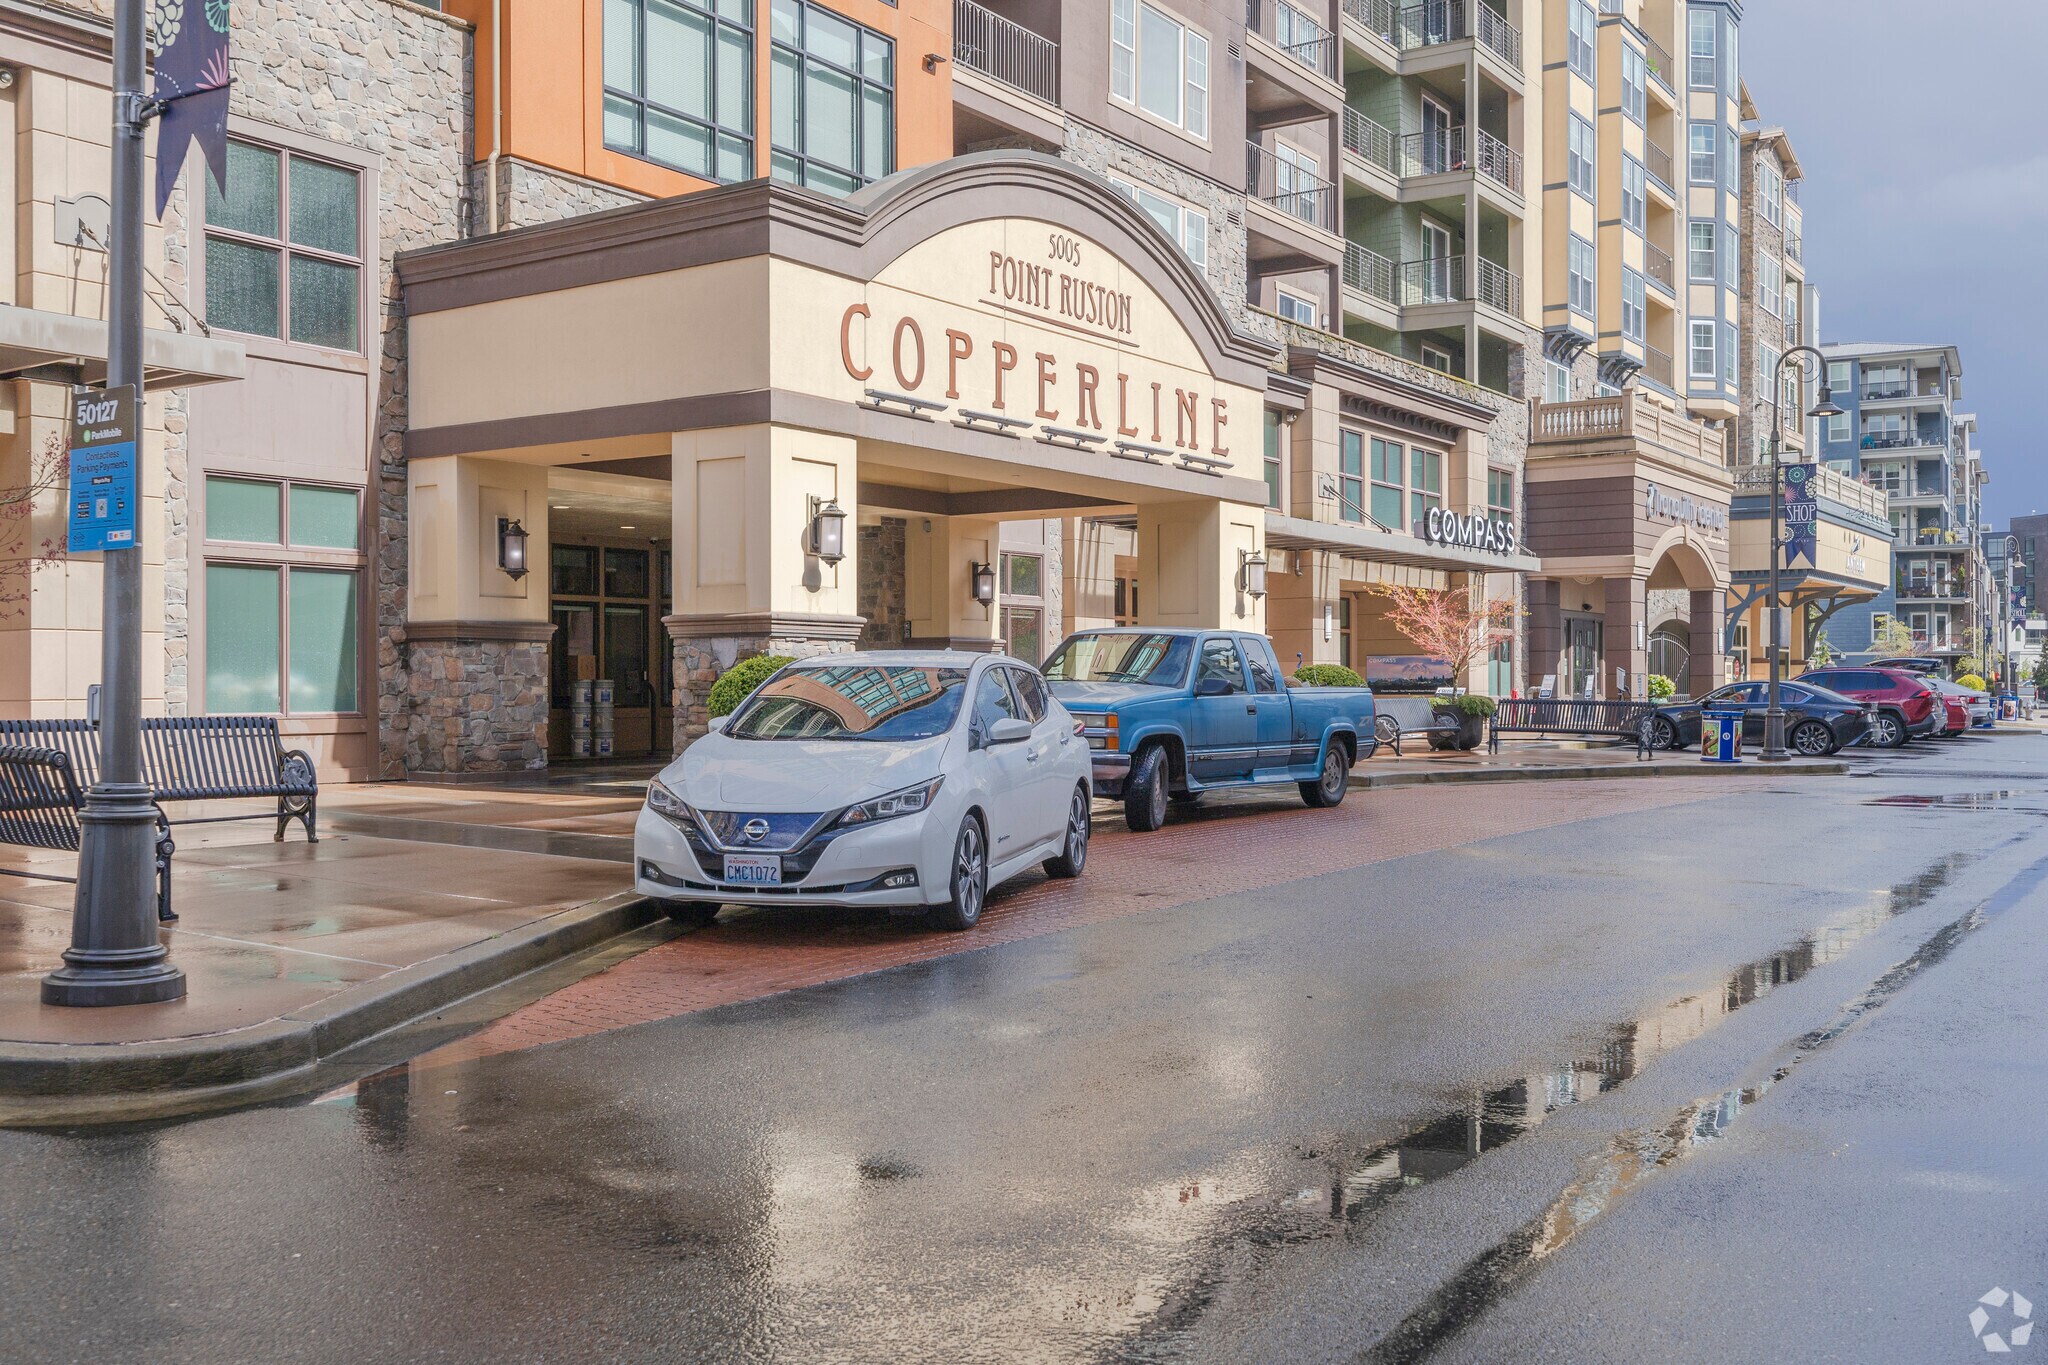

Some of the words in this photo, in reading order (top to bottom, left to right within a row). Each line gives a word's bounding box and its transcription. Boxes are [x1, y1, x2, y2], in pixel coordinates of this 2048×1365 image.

[1048, 233, 1081, 267] 5005
[990, 250, 1053, 310] POINT
[1059, 273, 1132, 335] RUSTON
[840, 302, 1231, 458] COPPERLINE
[77, 400, 119, 426] 50127
[91, 428, 122, 440] ParkMobile
[85, 450, 120, 461] Contactless
[77, 464, 99, 474] Parking
[99, 460, 128, 472] Payments
[1786, 504, 1816, 522] SHOP
[1428, 506, 1515, 552] COMPASS
[727, 865, 777, 881] CMC1072
